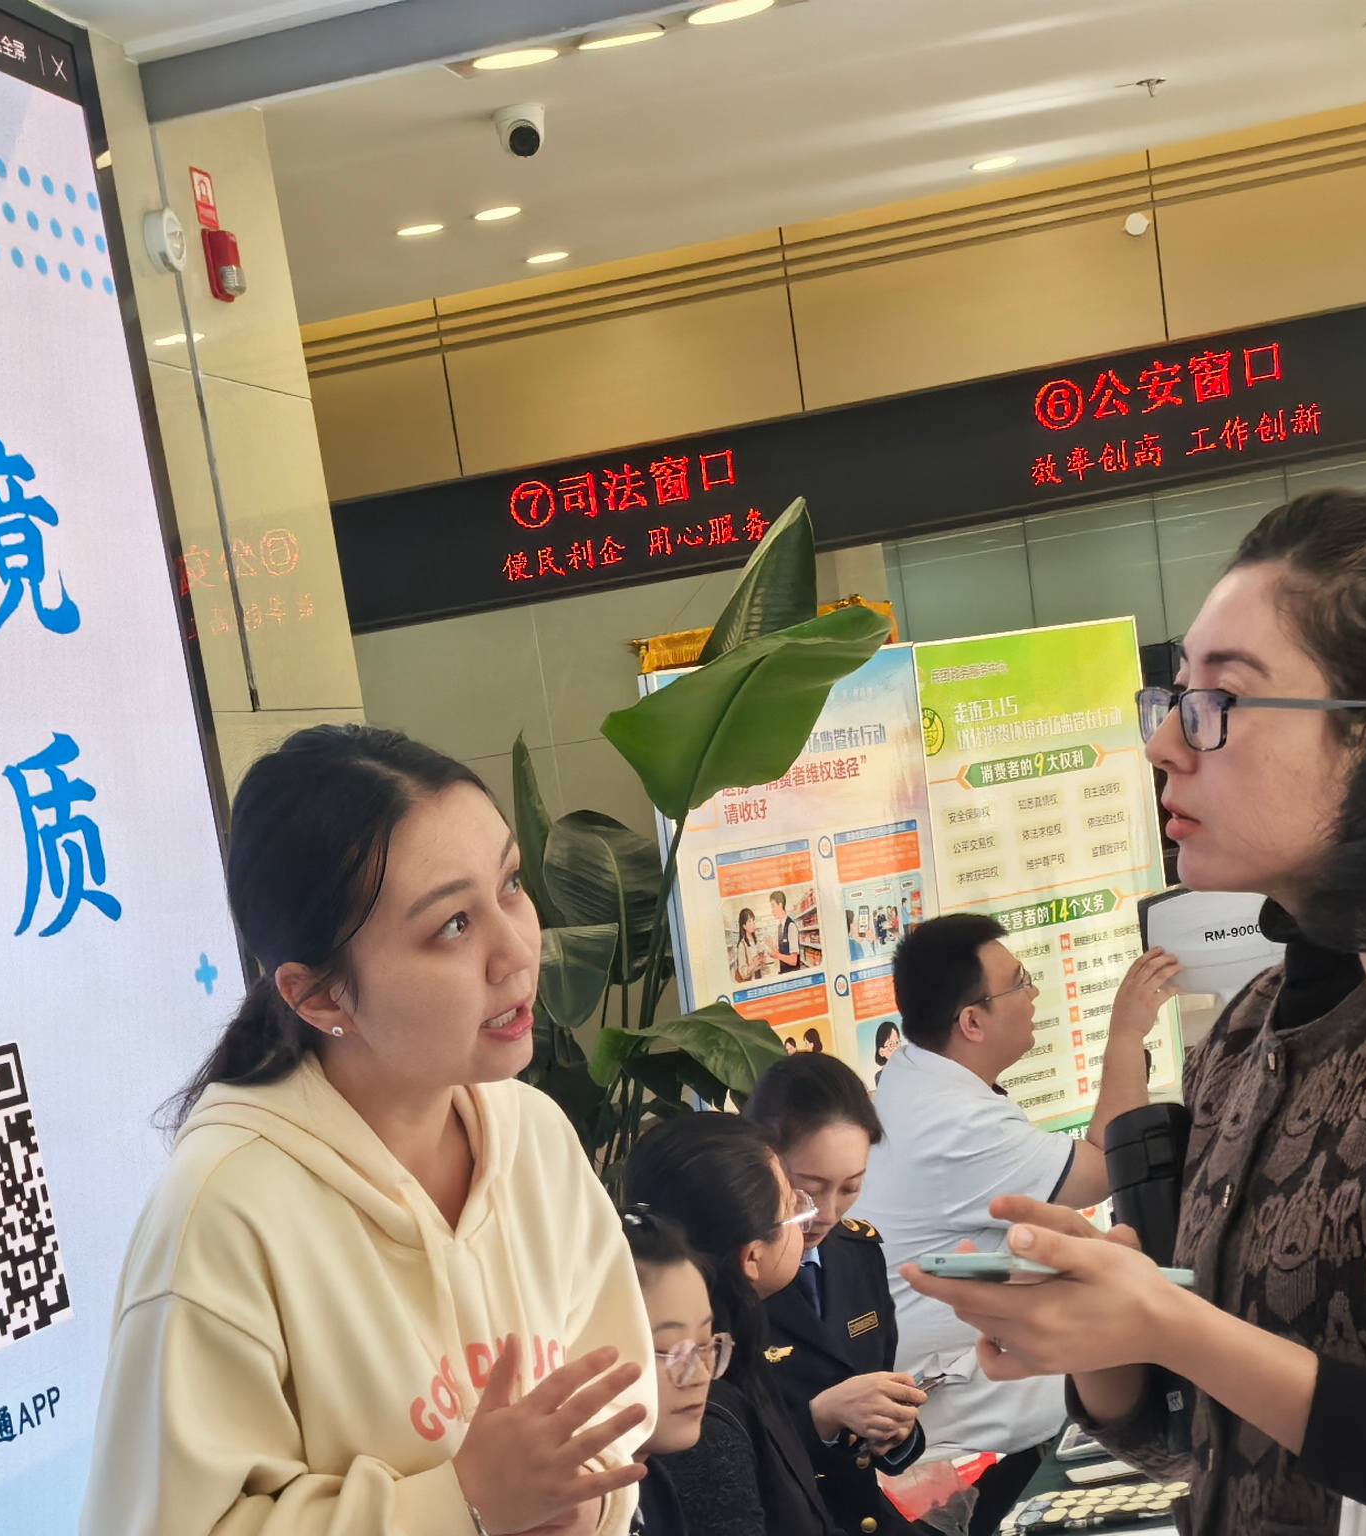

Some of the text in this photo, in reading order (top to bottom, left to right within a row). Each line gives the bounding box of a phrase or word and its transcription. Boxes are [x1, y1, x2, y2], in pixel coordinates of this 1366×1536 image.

[1031, 402, 1323, 486] 效率创高 工作创新
[501, 506, 771, 582] 便民利企 用心服务
[979, 749, 1084, 784] 消费者的9大权利
[723, 799, 767, 825] 请收好
